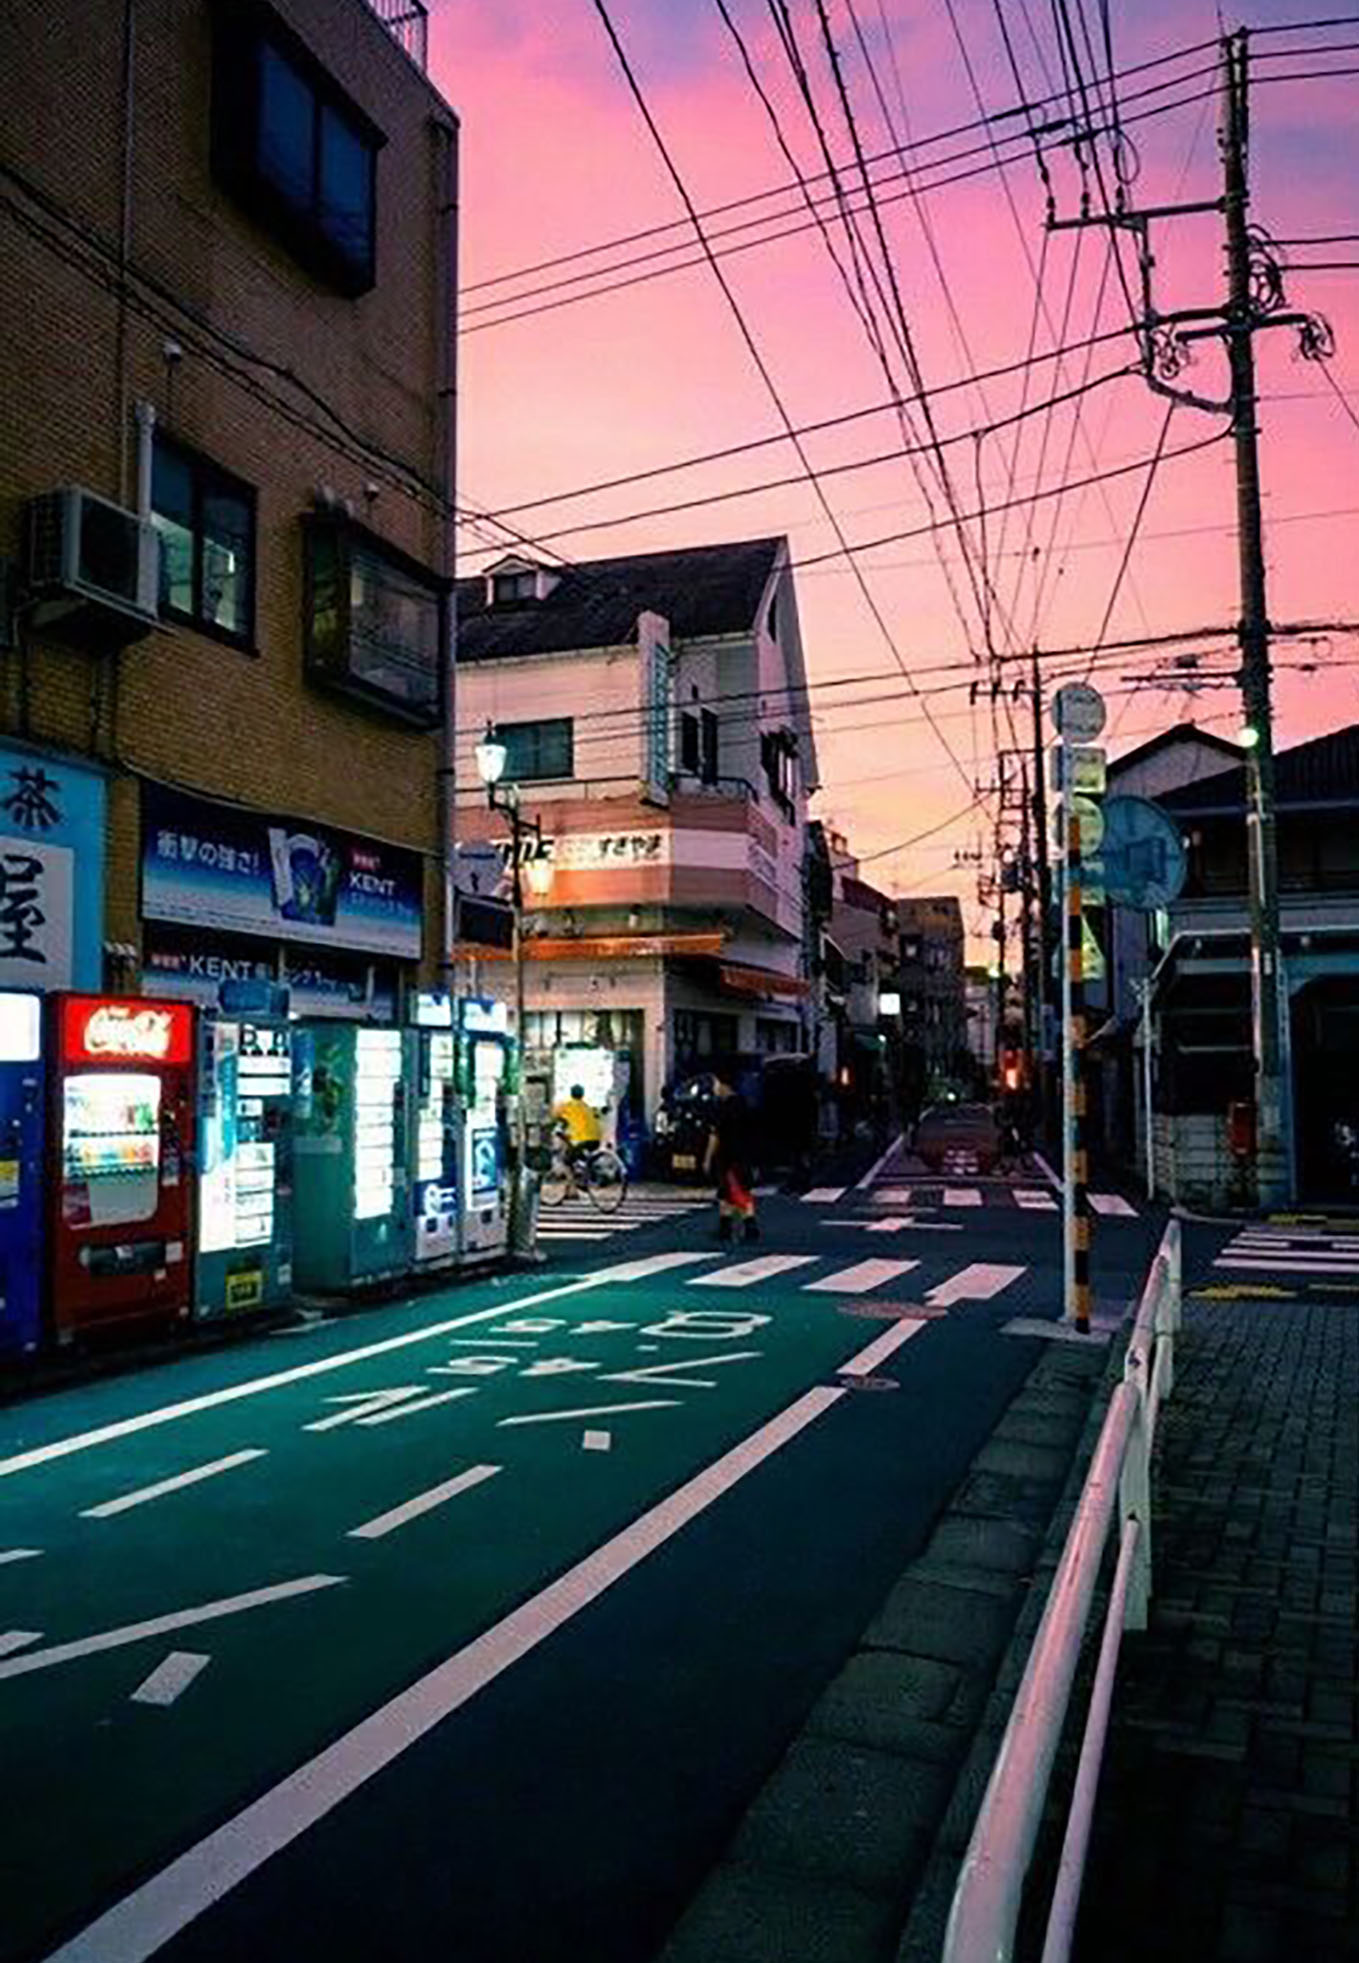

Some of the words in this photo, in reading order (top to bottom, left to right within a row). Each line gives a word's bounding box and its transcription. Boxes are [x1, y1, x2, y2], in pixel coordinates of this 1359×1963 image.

[3, 763, 65, 828] 茶
[349, 871, 396, 896] KENT
[189, 955, 252, 981] KENT
